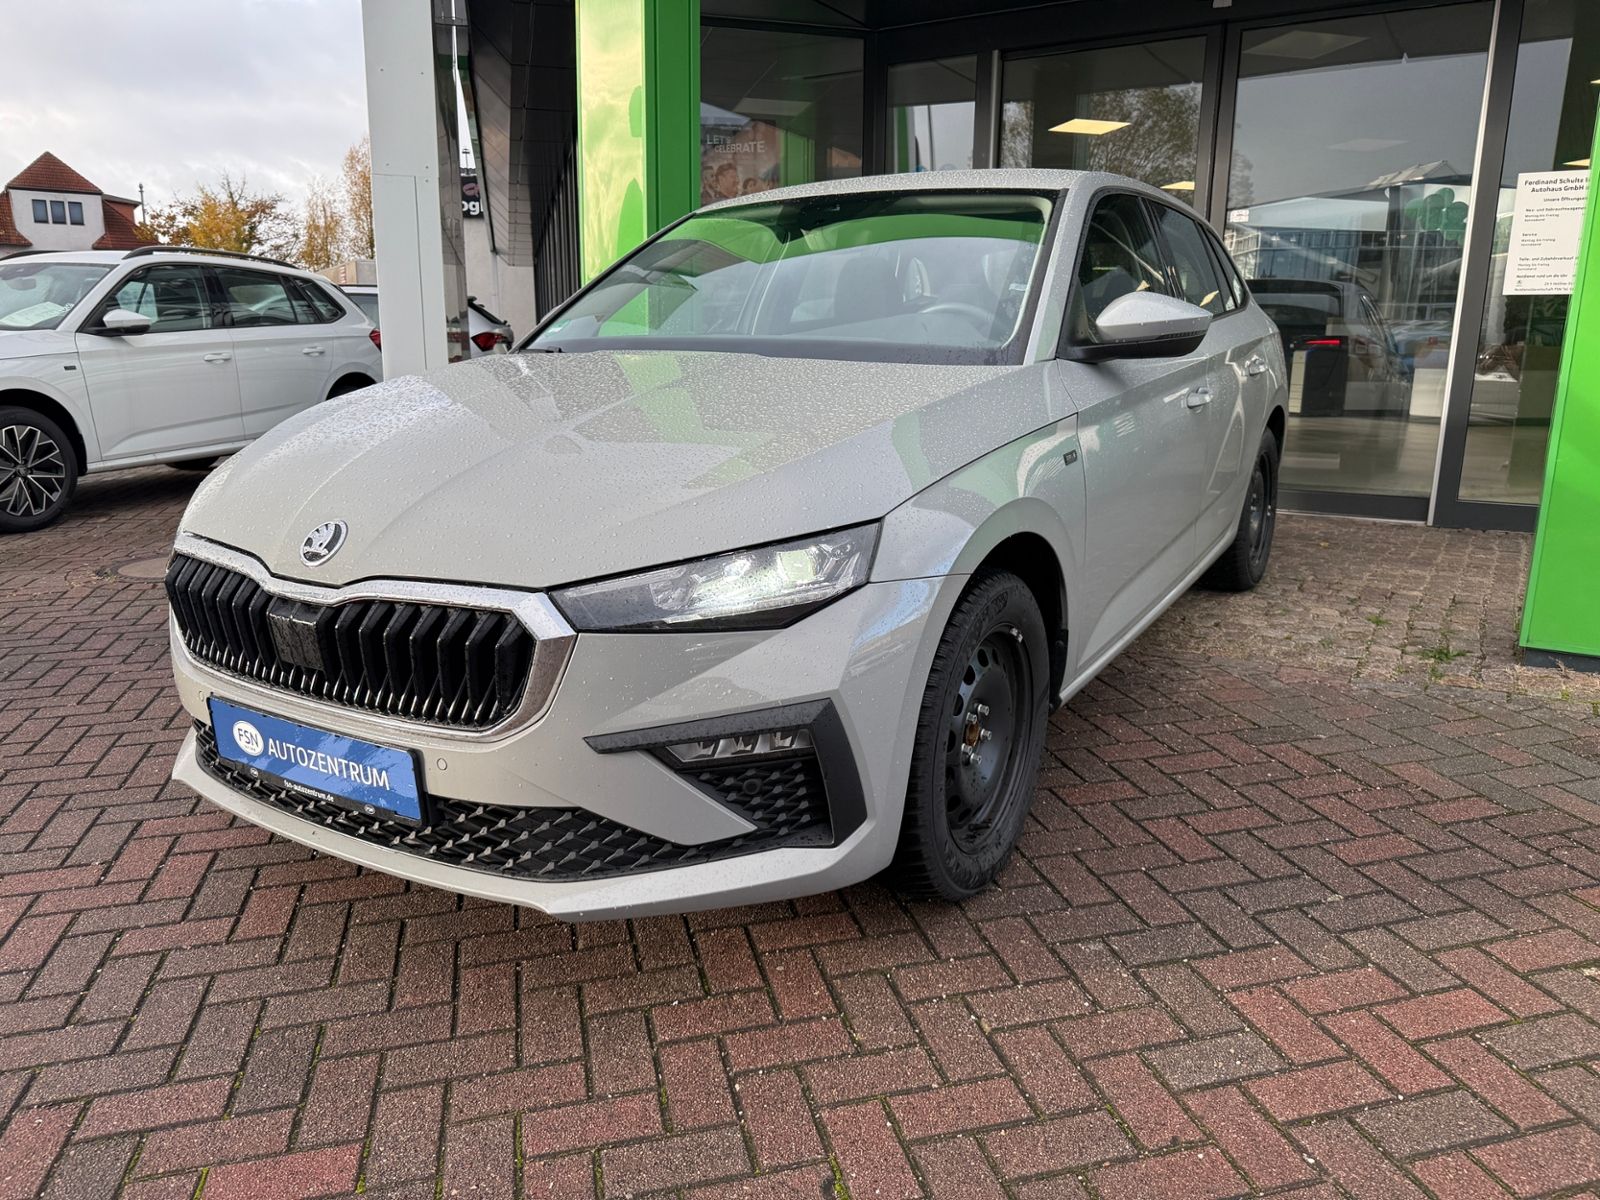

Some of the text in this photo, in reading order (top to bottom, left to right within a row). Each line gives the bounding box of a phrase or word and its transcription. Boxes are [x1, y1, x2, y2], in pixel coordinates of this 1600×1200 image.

[714, 140, 766, 153] CELEBRATE
[1524, 178, 1558, 186] Ferdinand
[237, 727, 390, 791] FSN AUTOZENTRUM
